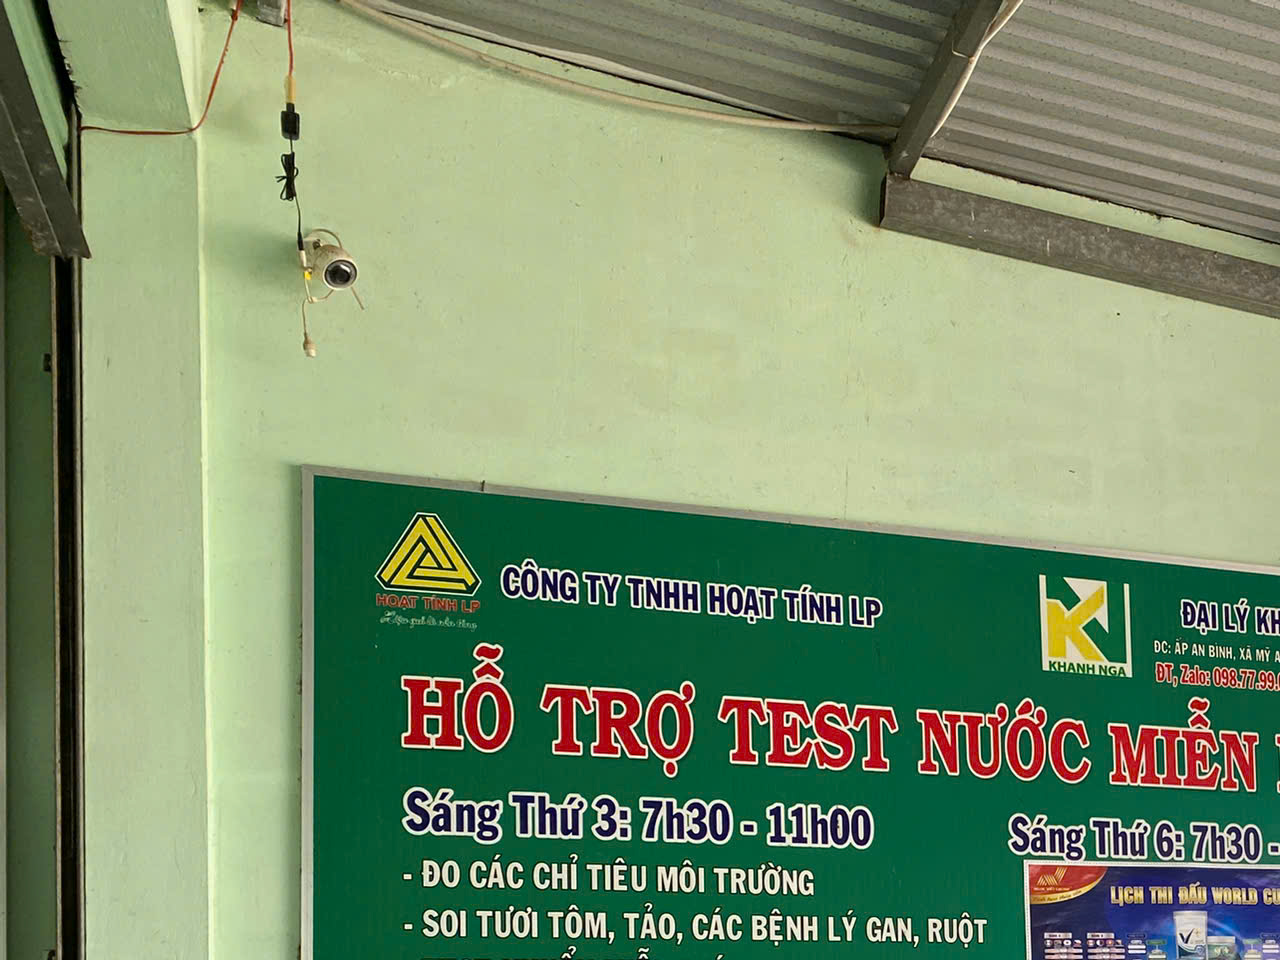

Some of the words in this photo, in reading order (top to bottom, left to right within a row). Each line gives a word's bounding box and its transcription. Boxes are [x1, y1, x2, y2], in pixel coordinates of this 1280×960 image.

[376, 593, 418, 610] HOẠT
[422, 595, 457, 611] TÍNH
[461, 600, 480, 613] LP
[501, 558, 577, 603] CÔNG
[584, 573, 620, 605] TY
[627, 577, 702, 614] TNHH
[707, 585, 775, 624] HOẠT
[784, 584, 843, 625] TÍNH
[849, 596, 883, 627] LP
[1180, 599, 1218, 635] ĐẠI
[1222, 598, 1248, 634] LÝ
[1049, 660, 1095, 674] KHANH
[1098, 665, 1127, 677] NGA
[1154, 640, 1171, 655] ĐC:
[1174, 637, 1189, 655] ẤP
[1191, 644, 1205, 658] AN
[1208, 642, 1236, 661] BÌNH,
[1239, 645, 1252, 661] XÃ
[1256, 646, 1271, 662] MỸ
[1155, 662, 1178, 686] ĐT,
[1180, 665, 1211, 687] Zalo:
[401, 642, 515, 753] HỖ
[540, 681, 696, 777] TRỢ
[717, 695, 899, 771] TEST
[917, 697, 1092, 784] NƯỚC
[1108, 697, 1259, 792] MIỄN
[401, 786, 502, 843] Sáng
[508, 791, 586, 841] Thứ
[592, 794, 632, 841] 3:
[642, 799, 734, 844] 7h30
[767, 802, 875, 849] 11h00
[1008, 812, 1084, 861] Sáng
[1092, 817, 1151, 861] Thứ
[1154, 822, 1185, 862] 6:
[1190, 824, 1261, 865] 7h30
[421, 859, 461, 888] ĐO
[469, 854, 524, 890] CÁC
[532, 853, 578, 891] CHỈ
[586, 857, 648, 893] TIÊU
[657, 859, 705, 893] MÔI
[713, 861, 815, 896] TRƯỜNG
[1110, 885, 1145, 906] LỊCH
[1149, 886, 1173, 904] THI
[1178, 881, 1207, 904] ĐẤU
[1211, 886, 1258, 905] WORLD
[422, 909, 467, 938] SOI
[476, 905, 539, 938] TƯƠI
[547, 903, 616, 945] TÔM,
[623, 902, 684, 945] TẢO,
[691, 907, 744, 942] CÁC
[751, 908, 819, 947] BỆNH
[828, 910, 857, 942] LÝ
[866, 916, 920, 947] GAN,
[927, 911, 988, 948] RUỘT
